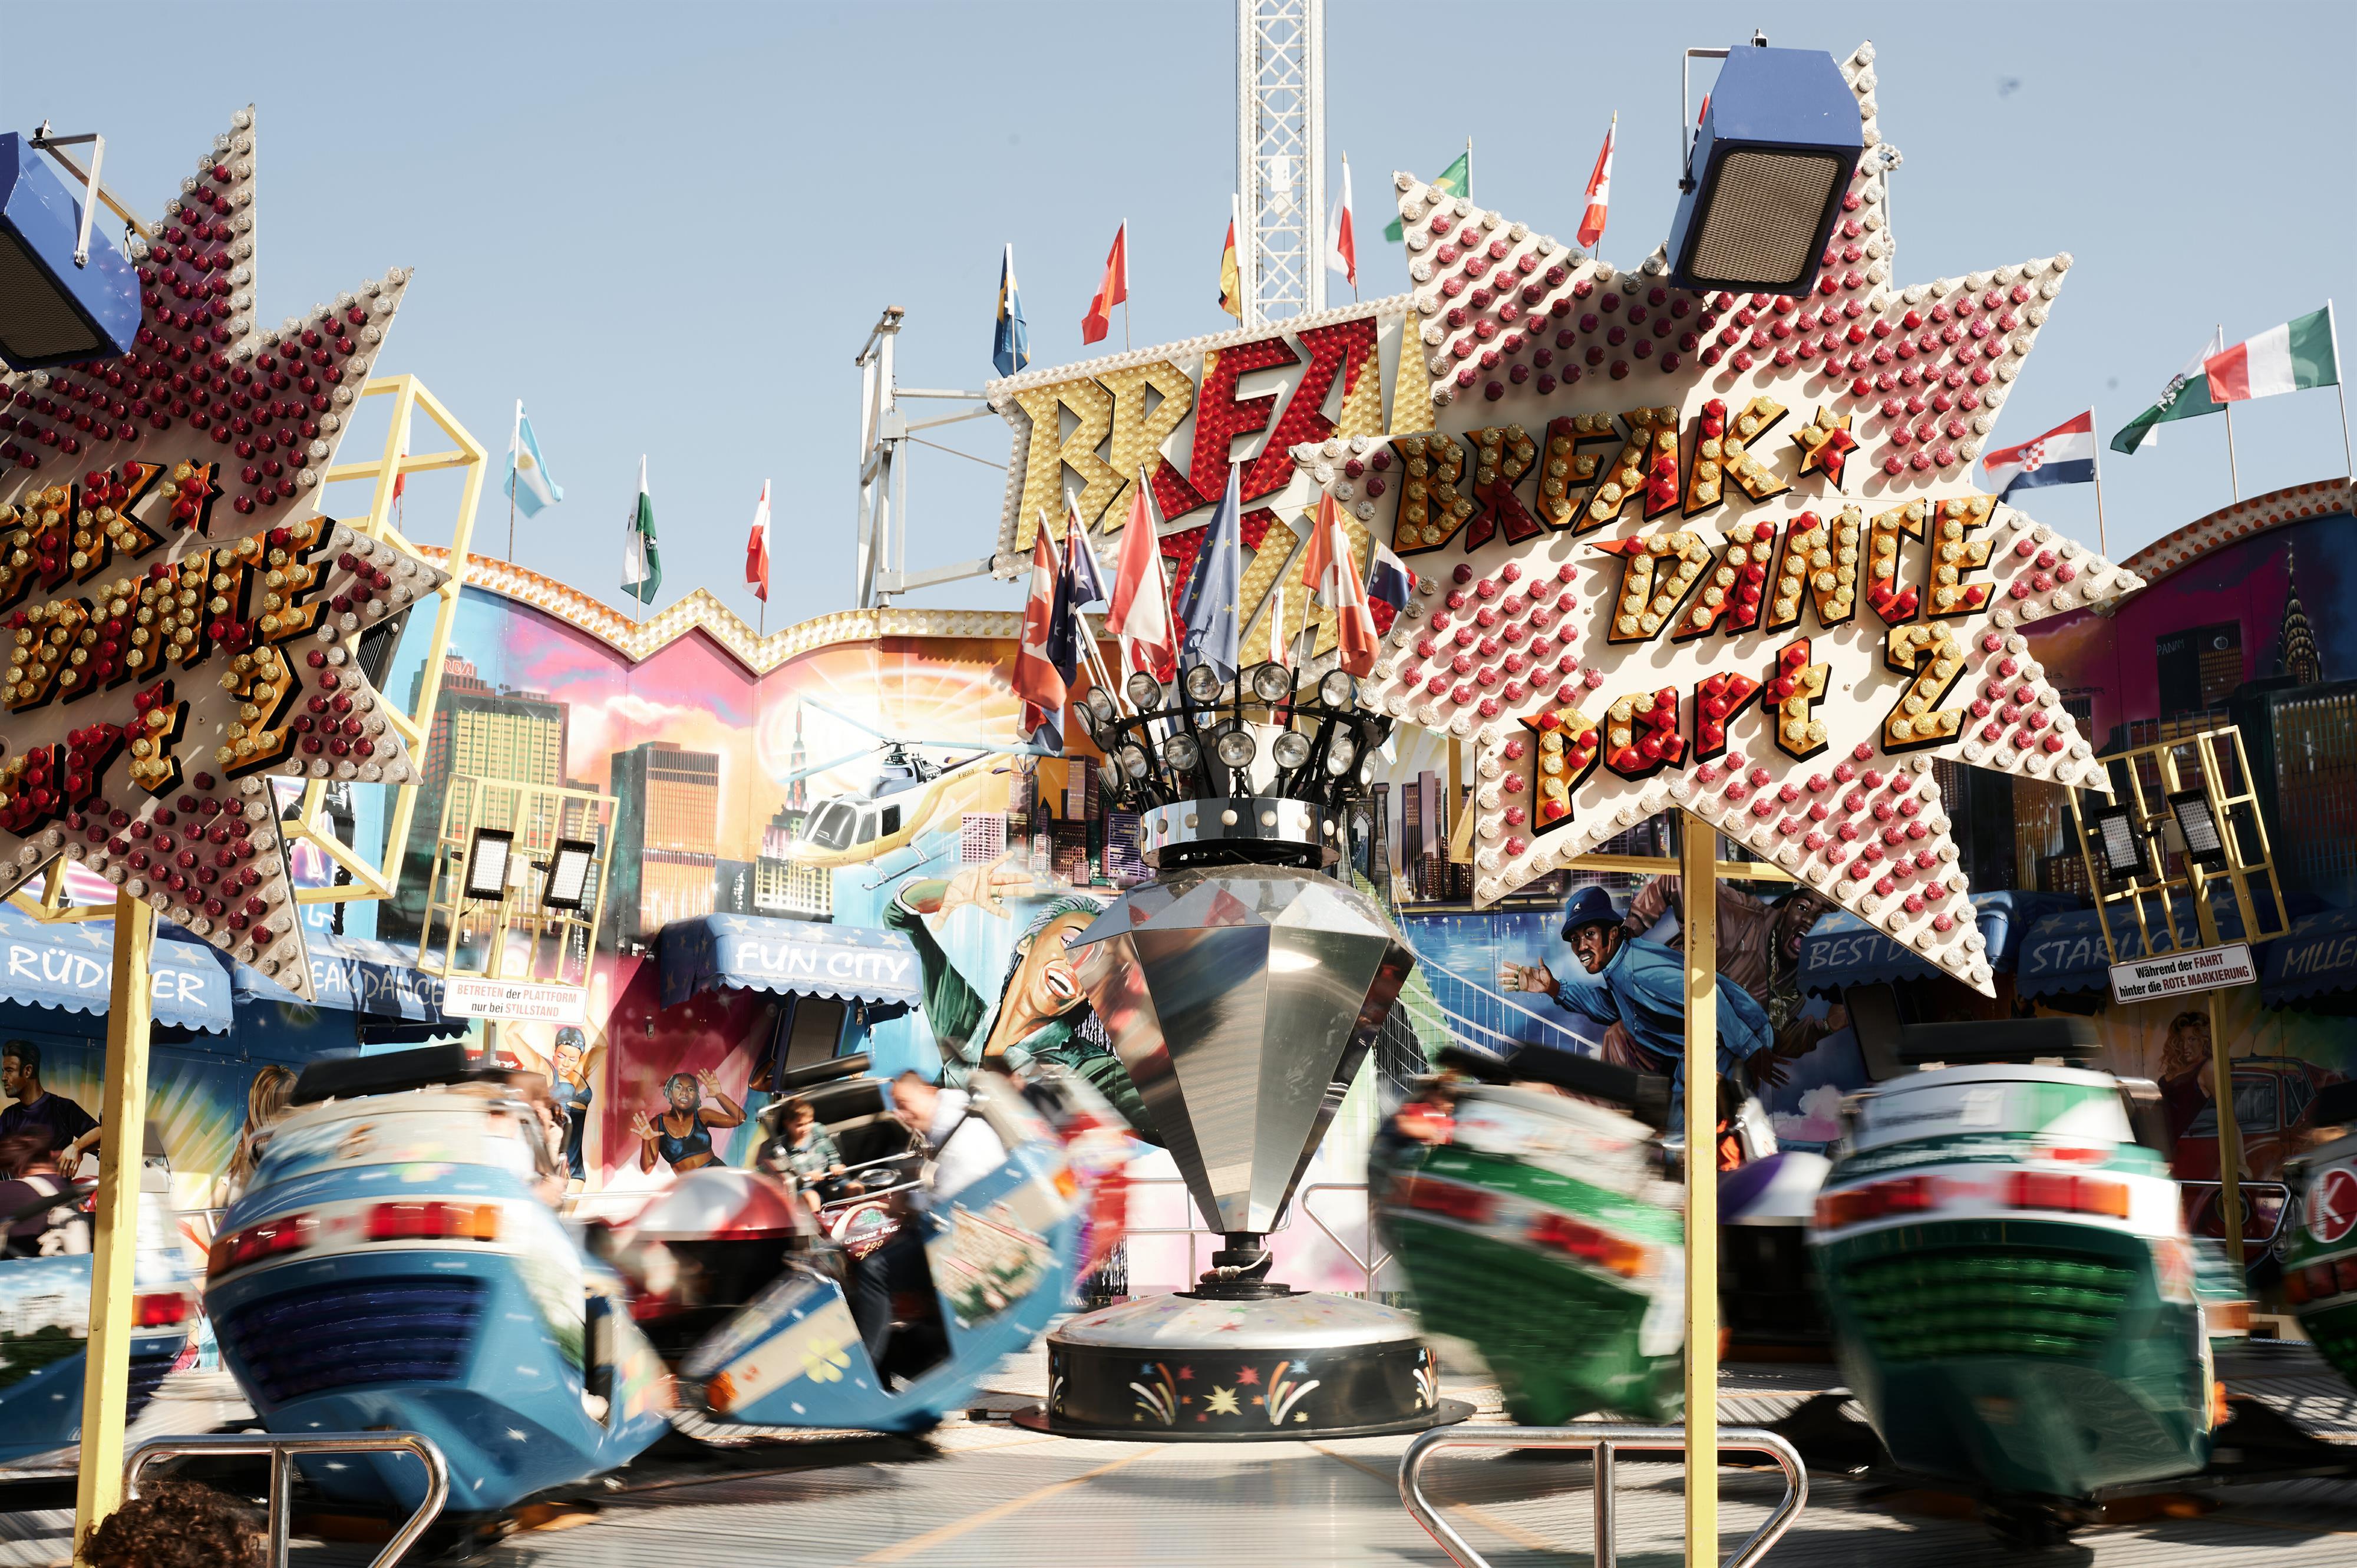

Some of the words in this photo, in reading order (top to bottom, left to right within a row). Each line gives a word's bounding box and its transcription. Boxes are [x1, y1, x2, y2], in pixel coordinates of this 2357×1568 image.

[1391, 397, 1794, 556] BREAK
[1584, 494, 1999, 645] DANCE
[0, 516, 335, 714] DANCE
[1884, 620, 1968, 755] 2
[221, 645, 302, 781] 2
[735, 942, 817, 973] FUN
[826, 952, 910, 982] CITY
[1807, 935, 1882, 970] BEST
[2030, 921, 2223, 973] STARLIGH
[2135, 961, 2177, 979] Während
[2177, 960, 2193, 972] der
[2193, 953, 2223, 969] FAHRT
[2282, 935, 2357, 978] MILLE
[8, 945, 208, 1007] RÜDER
[457, 984, 503, 998] BETRETEN
[506, 989, 521, 1000] der
[523, 990, 577, 1003] PLATTFORM
[2118, 983, 2145, 998] hinter
[2148, 981, 2162, 993] die
[2162, 976, 2187, 990] ROTE
[2187, 965, 2250, 986] MARKIERUNG
[471, 1002, 487, 1012] nur
[489, 1002, 504, 1014] bei
[505, 1003, 559, 1017] STILLSTAND
[844, 1230, 879, 1245] Grazer
